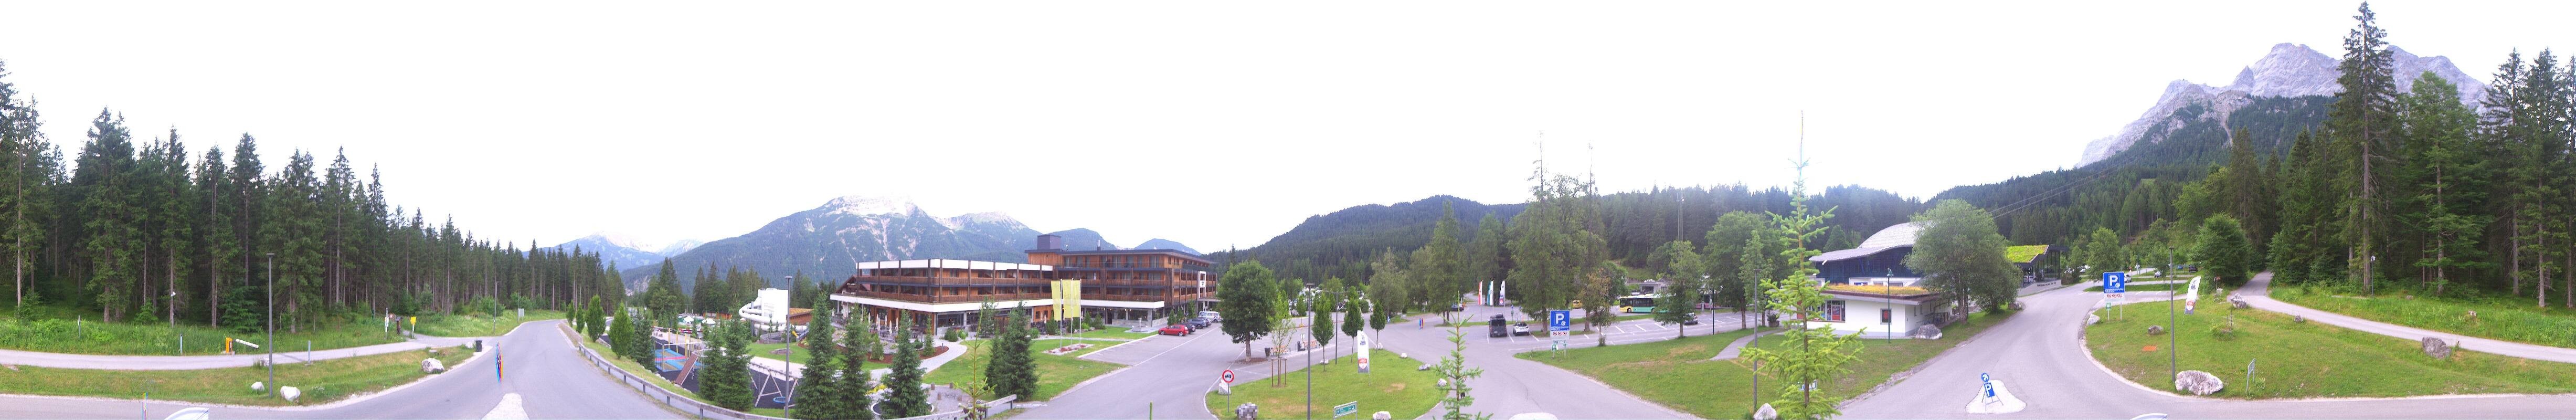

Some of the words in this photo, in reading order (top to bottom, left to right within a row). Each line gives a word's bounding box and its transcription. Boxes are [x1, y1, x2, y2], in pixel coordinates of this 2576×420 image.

[2109, 275, 2118, 286] P
[1556, 313, 1564, 324] P
[1985, 384, 1991, 397] P
